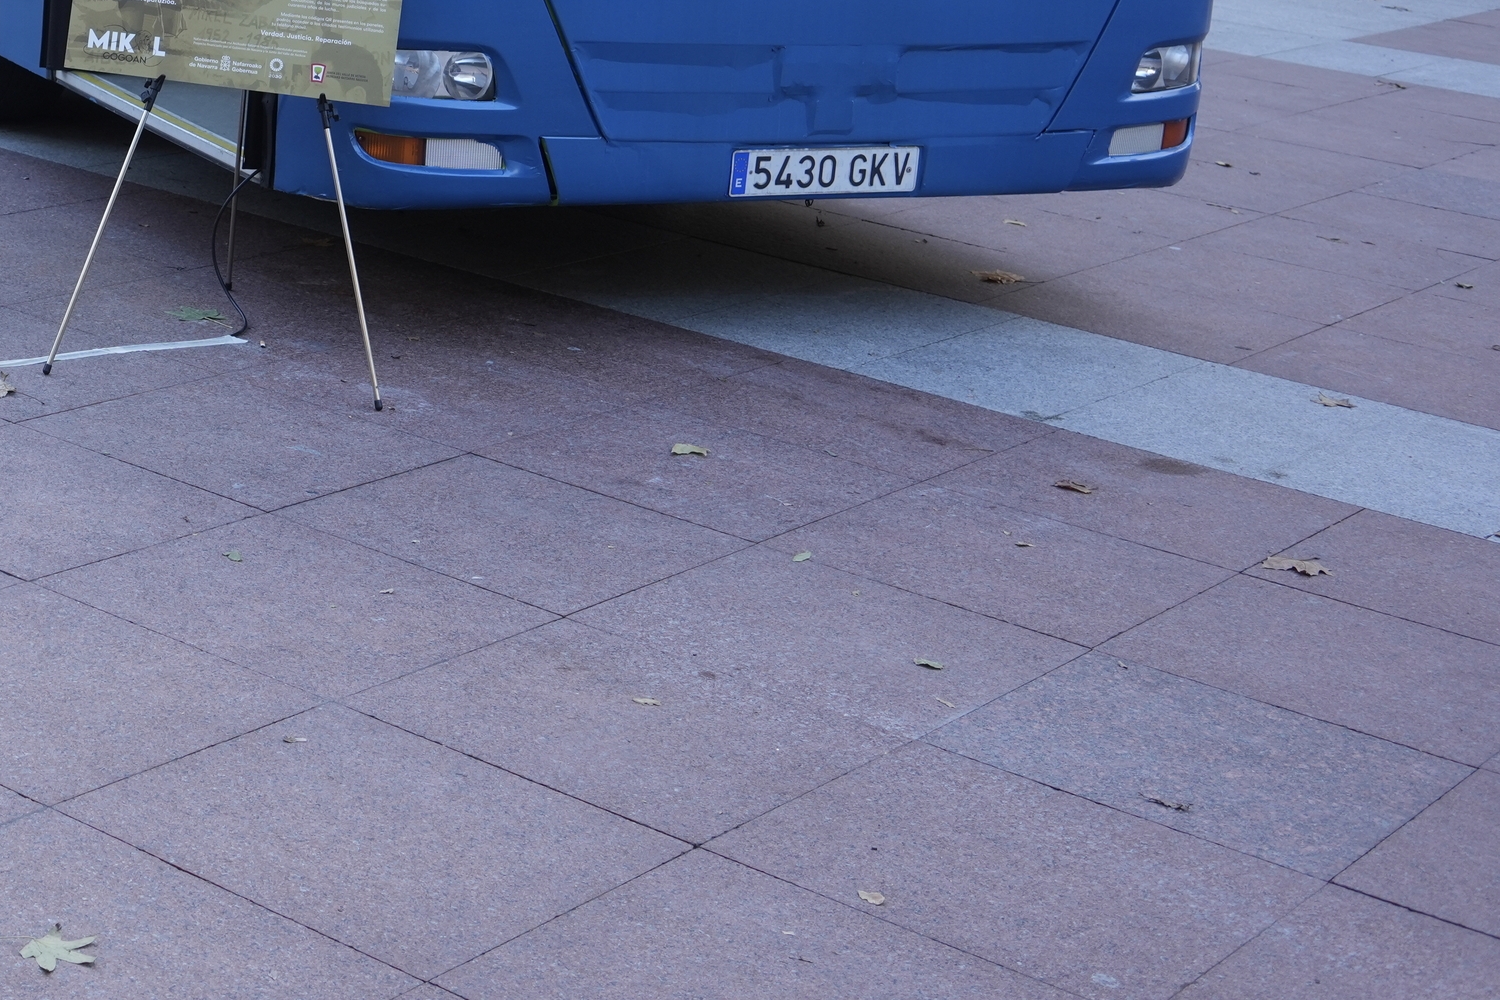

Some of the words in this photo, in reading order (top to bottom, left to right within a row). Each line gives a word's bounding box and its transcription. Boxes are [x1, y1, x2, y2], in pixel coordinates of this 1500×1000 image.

[102, 51, 146, 64] GOGOAN
[232, 60, 262, 68] Nafarroako
[753, 154, 837, 190] 5430
[849, 152, 911, 187] GKV
